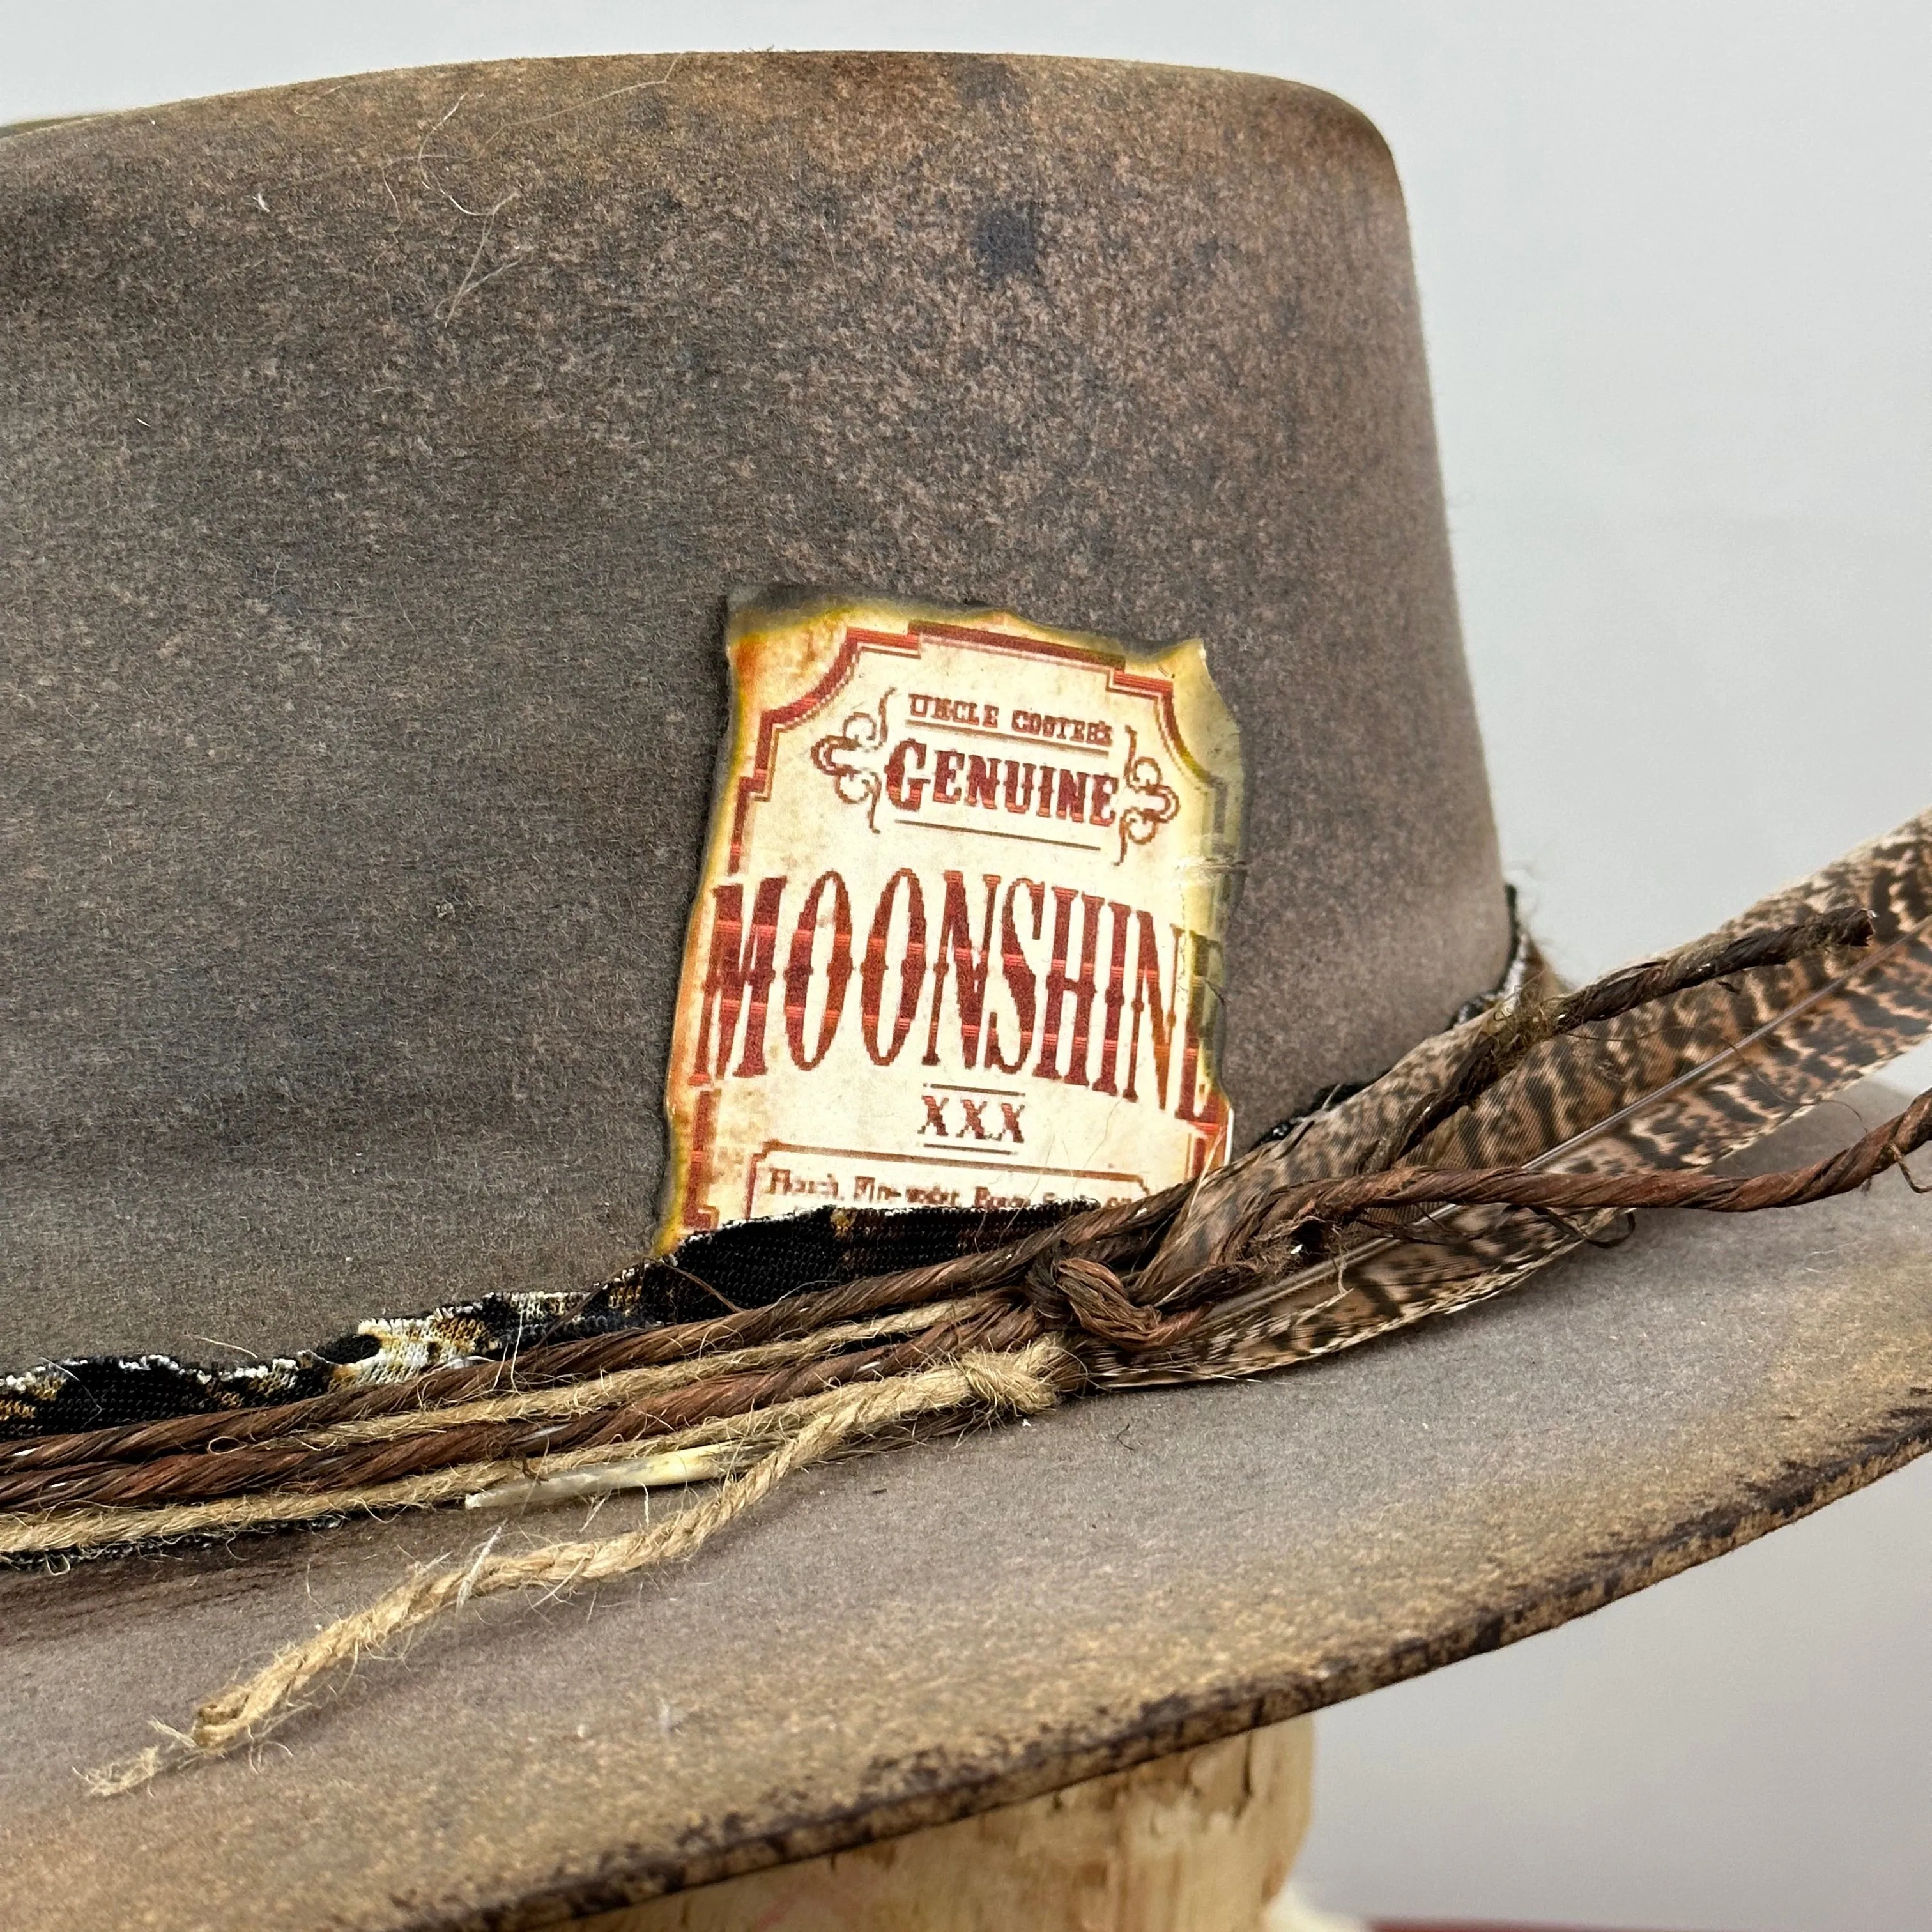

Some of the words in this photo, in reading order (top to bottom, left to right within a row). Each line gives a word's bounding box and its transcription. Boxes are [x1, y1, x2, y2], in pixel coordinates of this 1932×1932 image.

[909, 693, 999, 728] UNCLE
[884, 737, 1119, 827] GENUINE
[917, 1095, 1025, 1143] XXX
